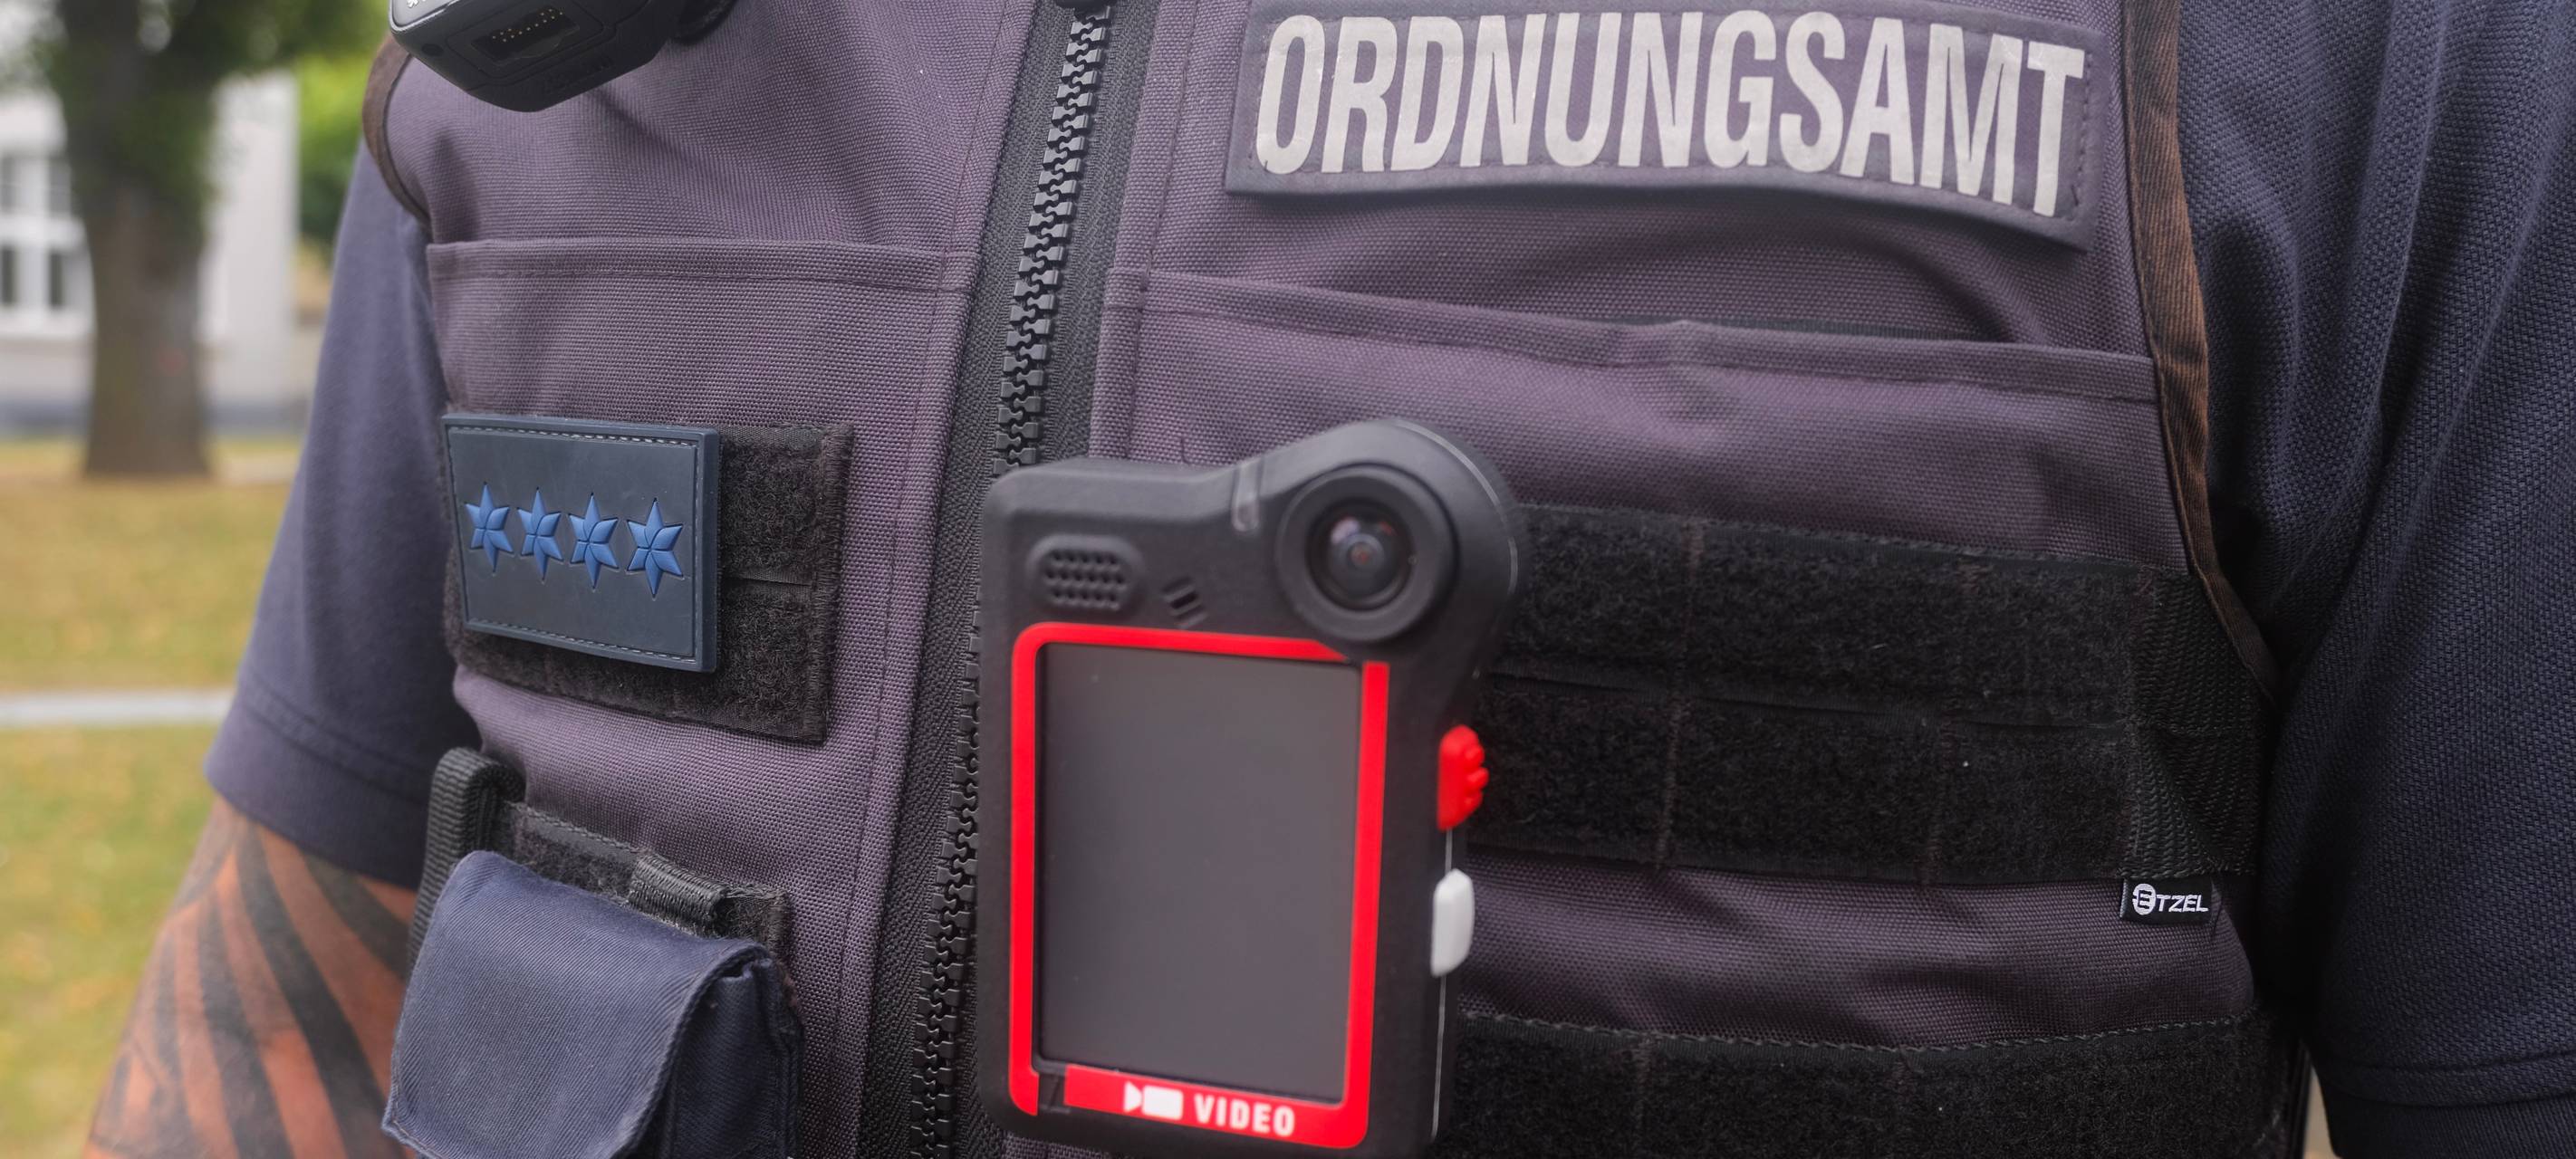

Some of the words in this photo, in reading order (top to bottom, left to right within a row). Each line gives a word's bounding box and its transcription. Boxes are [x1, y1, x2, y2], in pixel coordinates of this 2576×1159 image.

[1255, 10, 2084, 217] ORDNUNGSAMT
[2132, 883, 2209, 915] ETZEL
[1194, 1093, 1295, 1136] VIDEO
